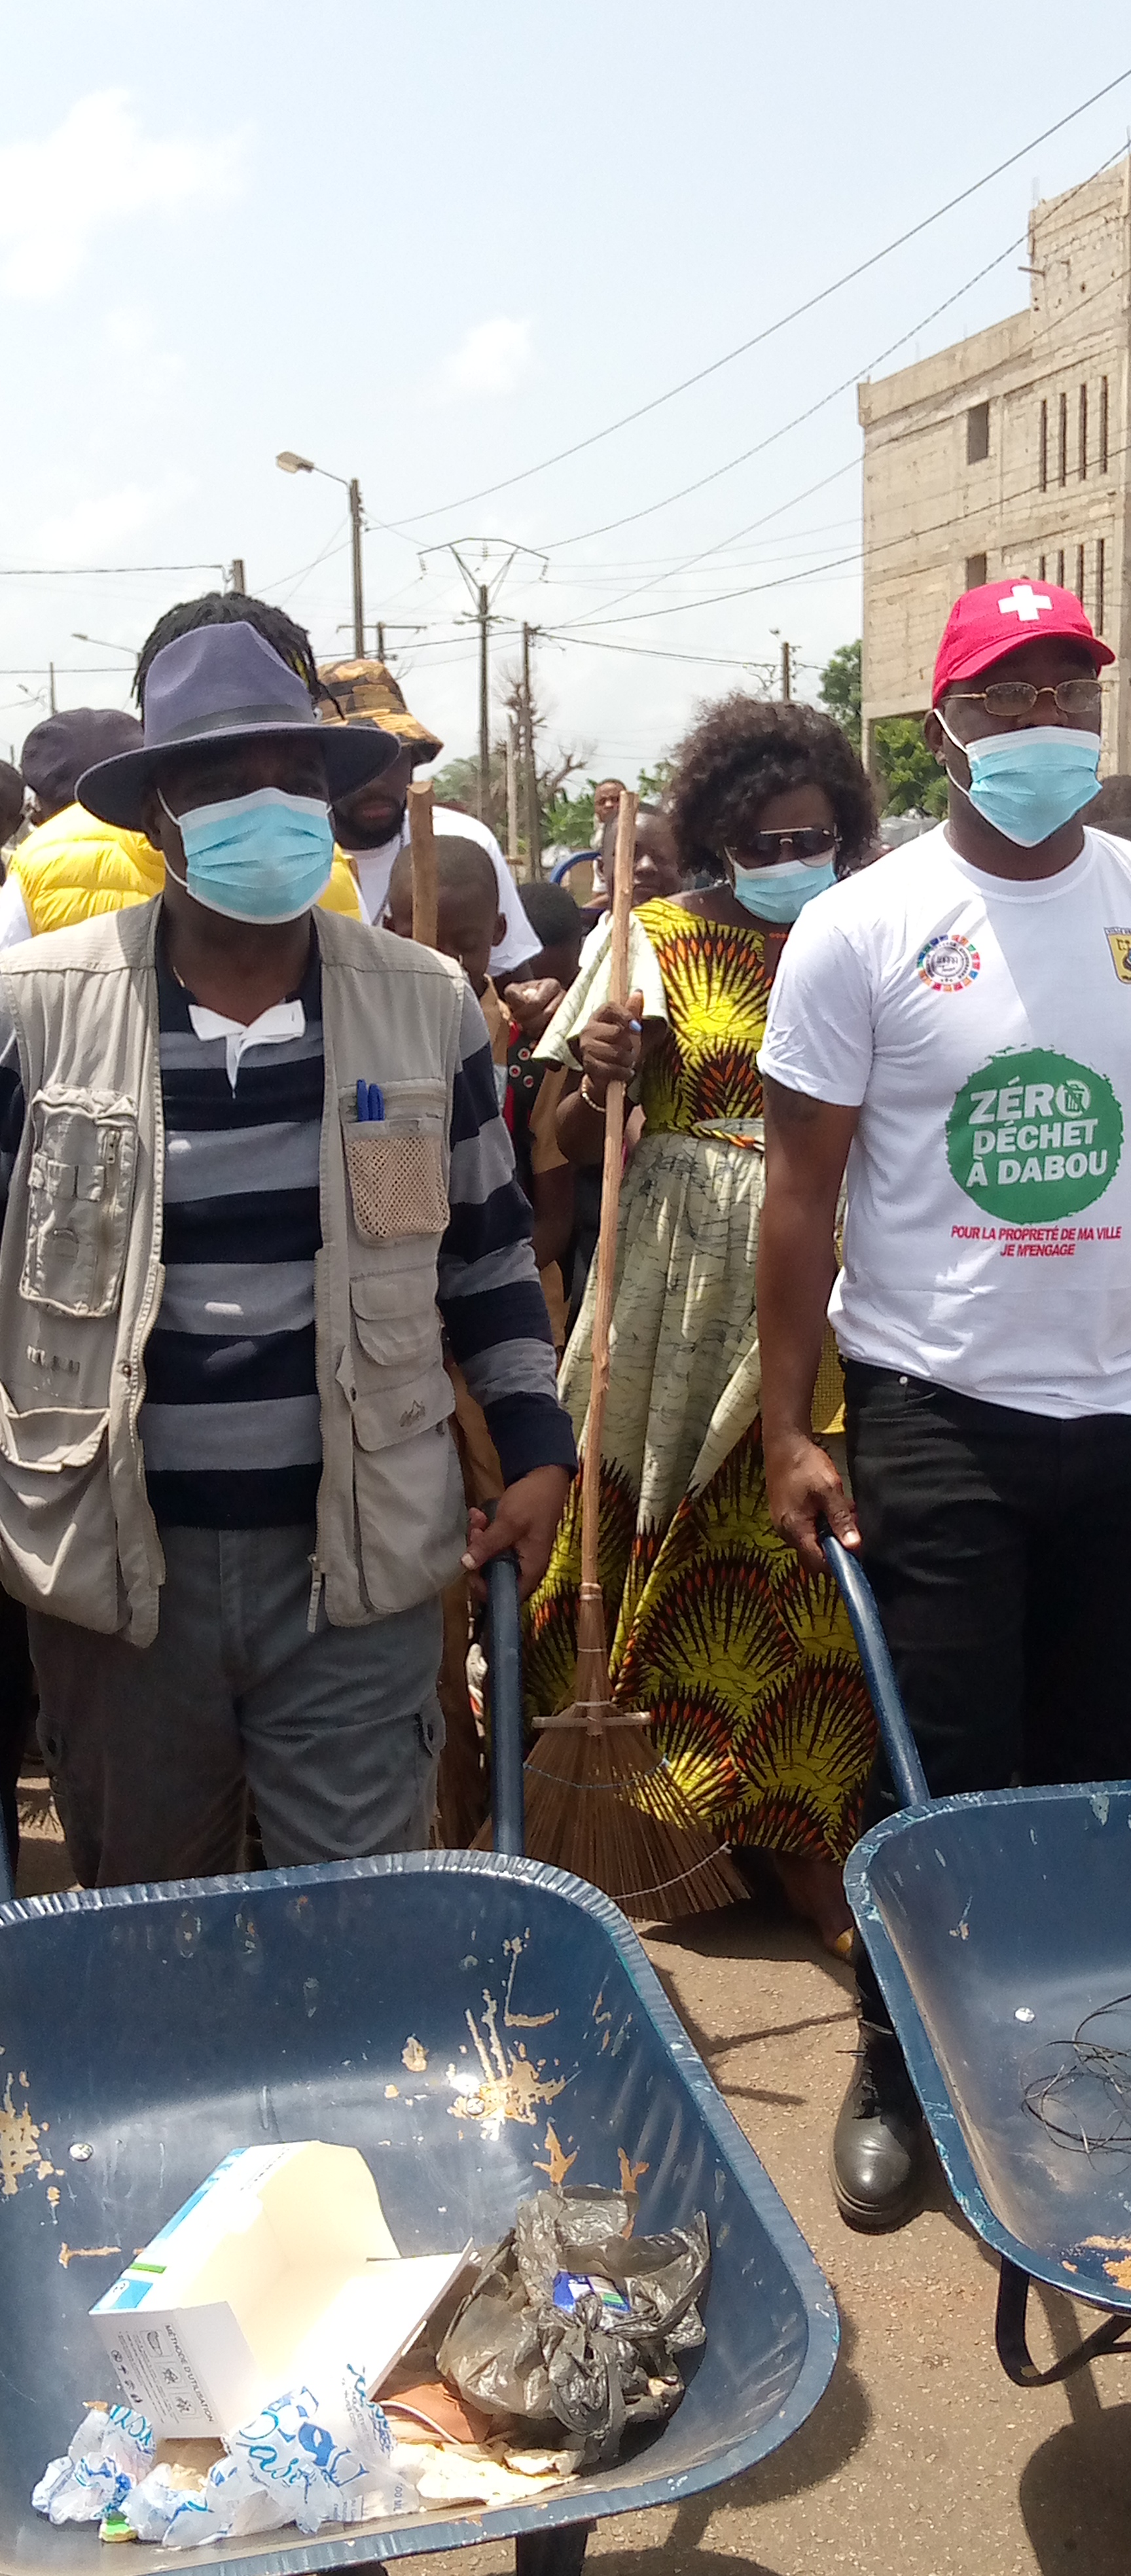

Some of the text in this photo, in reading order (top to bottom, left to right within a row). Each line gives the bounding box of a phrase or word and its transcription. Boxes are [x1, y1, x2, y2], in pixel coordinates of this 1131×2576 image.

[973, 1118, 1098, 1155] DÉCHET
[966, 1149, 1107, 1188] À DABOU
[951, 1225, 1122, 1241] POUR LA PROPRETÉ DE MA VILLE
[1000, 1243, 1076, 1257] JE M'ENGAGE
